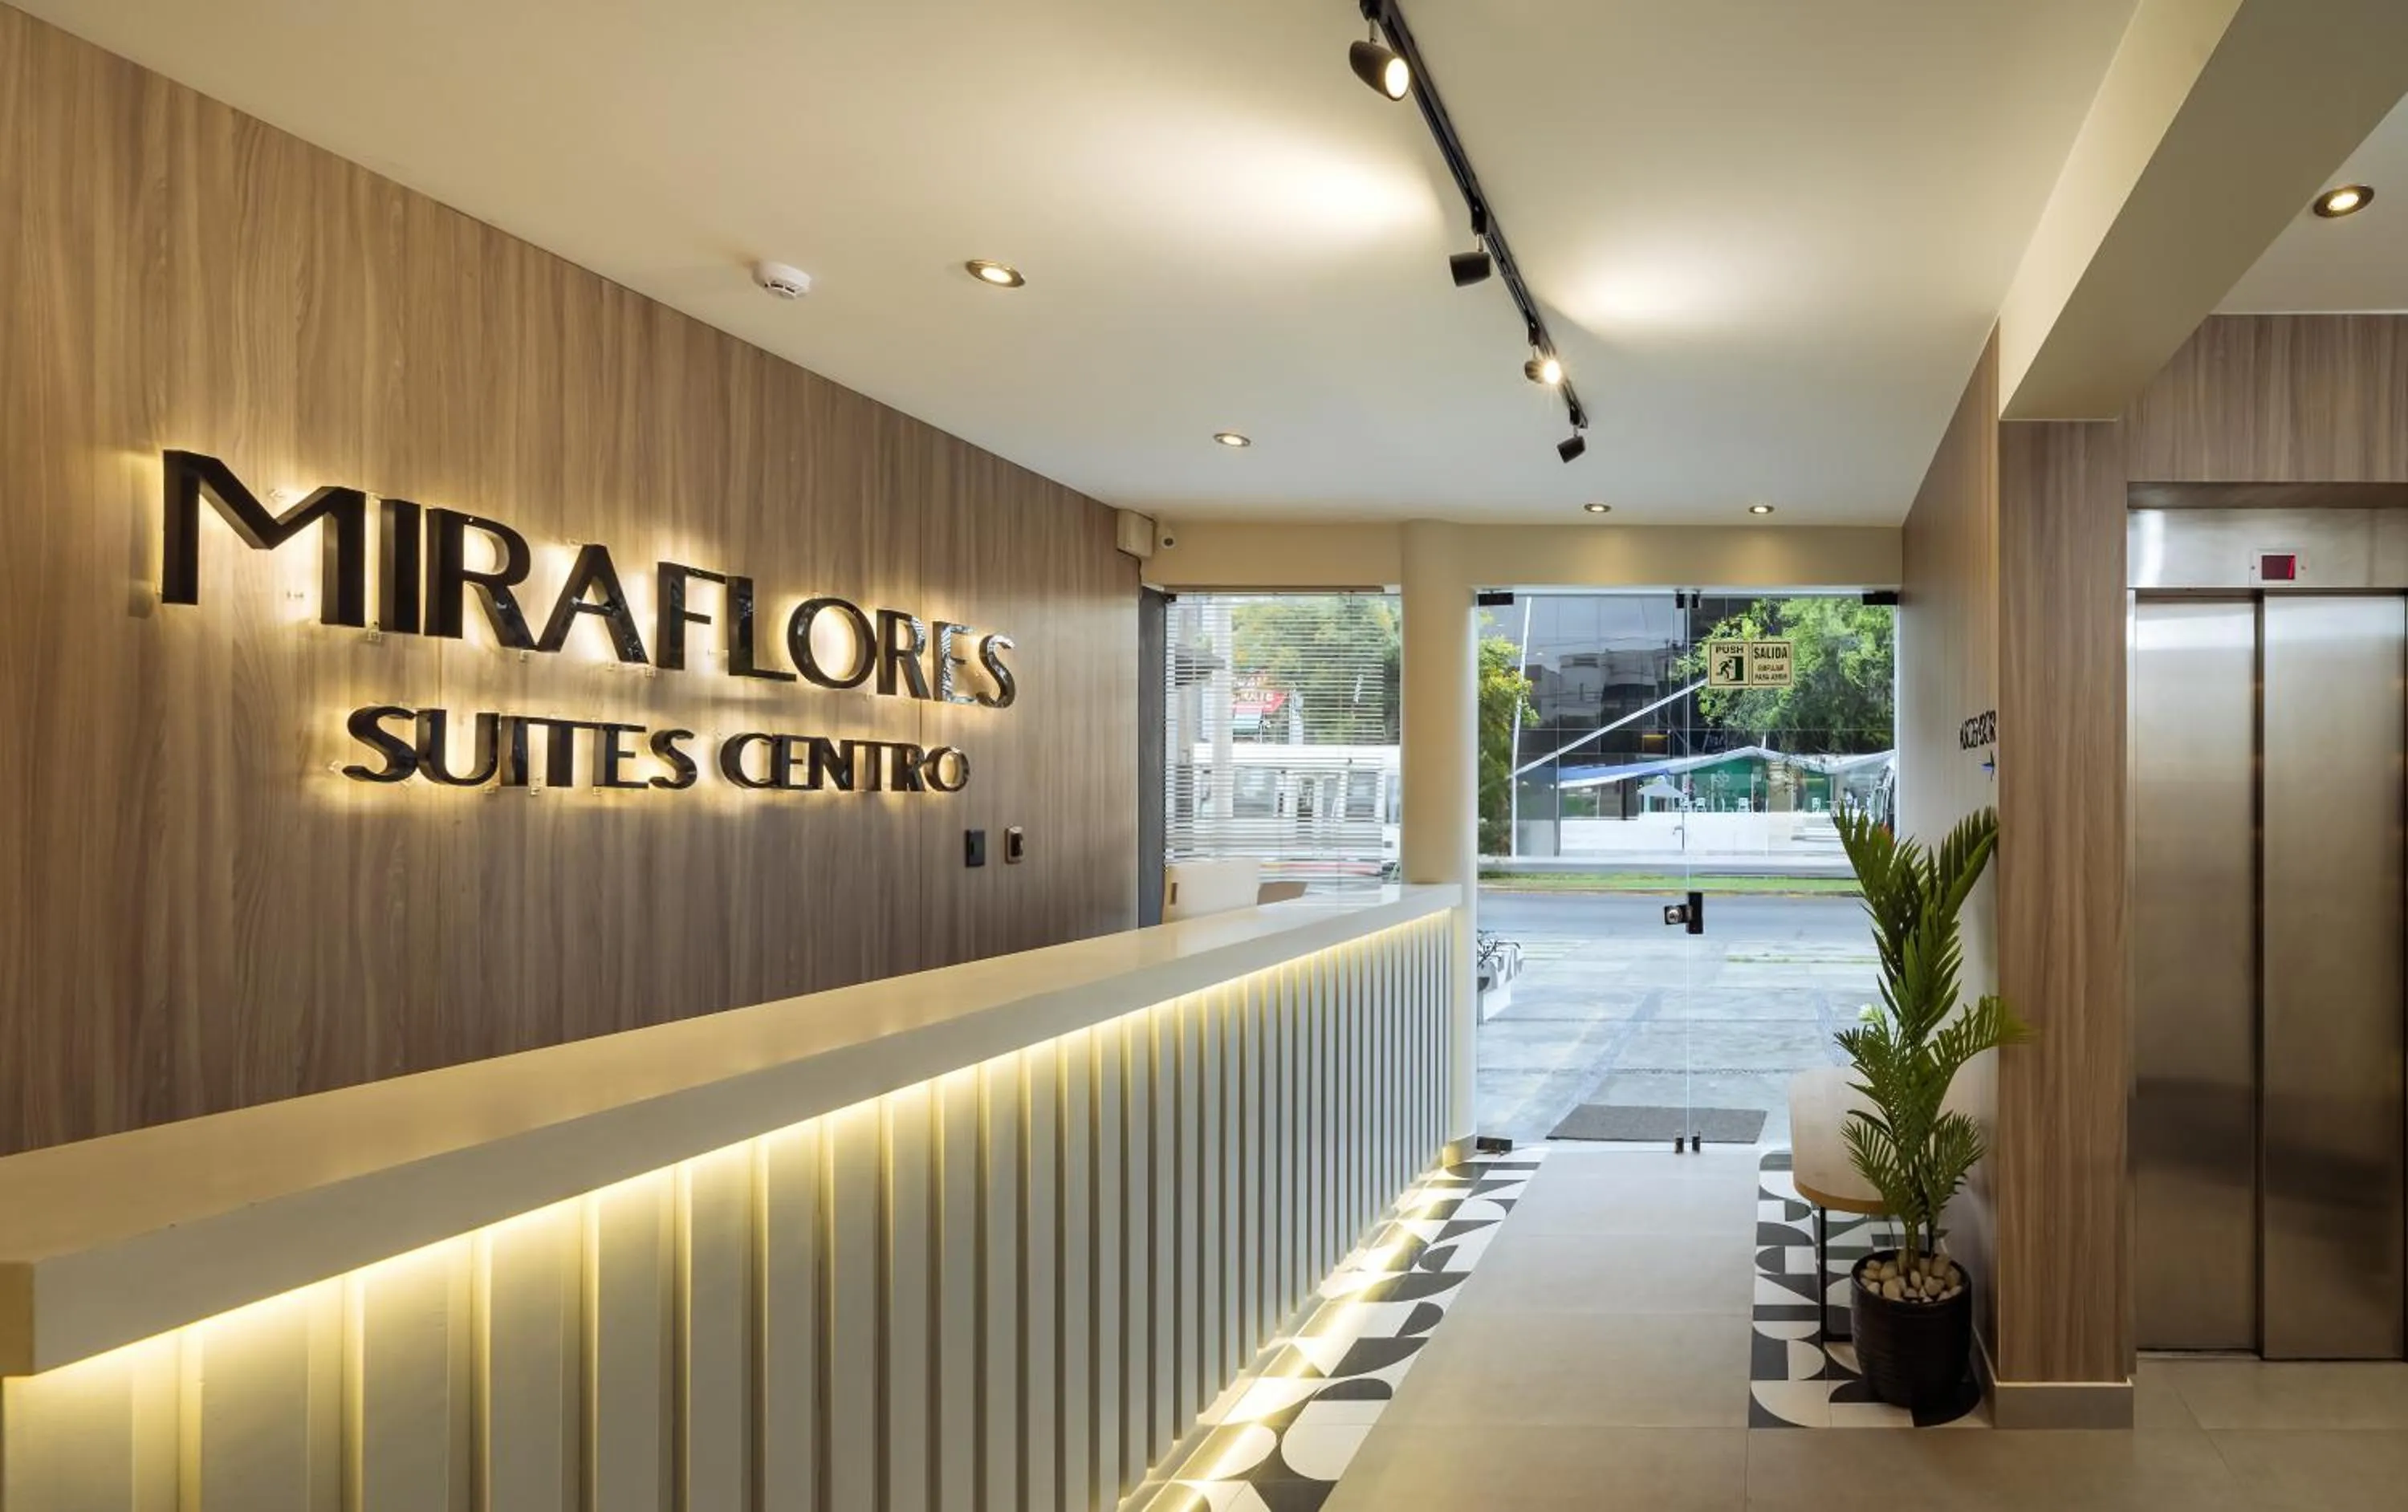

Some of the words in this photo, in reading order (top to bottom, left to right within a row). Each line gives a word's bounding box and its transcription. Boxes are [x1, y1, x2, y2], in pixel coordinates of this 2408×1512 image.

[162, 450, 1015, 708] MIRAFLORES
[1715, 645, 1743, 654] PUSH
[1754, 647, 1788, 659] SALIDA
[344, 705, 698, 790] SUITES
[720, 733, 970, 791] CENTRO
